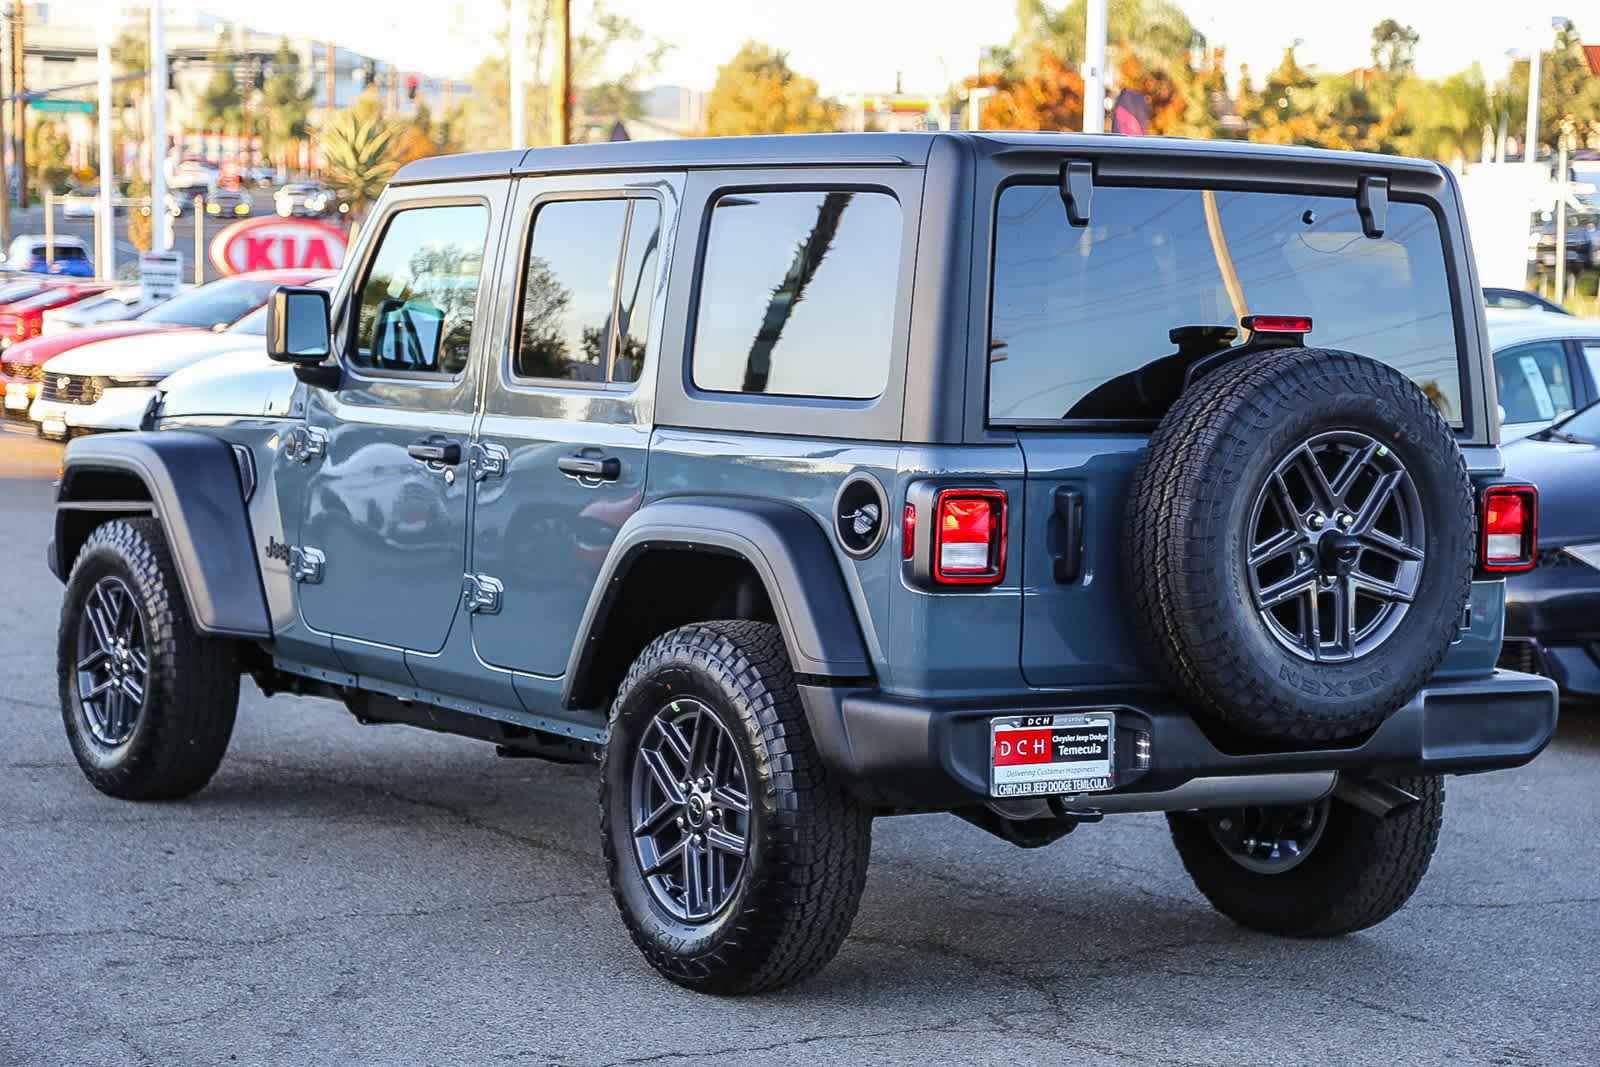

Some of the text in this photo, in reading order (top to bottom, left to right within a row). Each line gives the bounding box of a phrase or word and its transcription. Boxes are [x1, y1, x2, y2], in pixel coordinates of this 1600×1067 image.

[246, 236, 332, 269] KIA
[265, 535, 290, 566] Jeep
[1027, 717, 1050, 726] DCH
[1052, 732, 1108, 743] Chrysler Jeep Dodge
[1000, 739, 1045, 756] DCH
[1058, 743, 1102, 755] Temecula
[998, 783, 1032, 795] CHRYSLER
[1032, 783, 1048, 793] JEEP
[1048, 781, 1073, 792] DODGE
